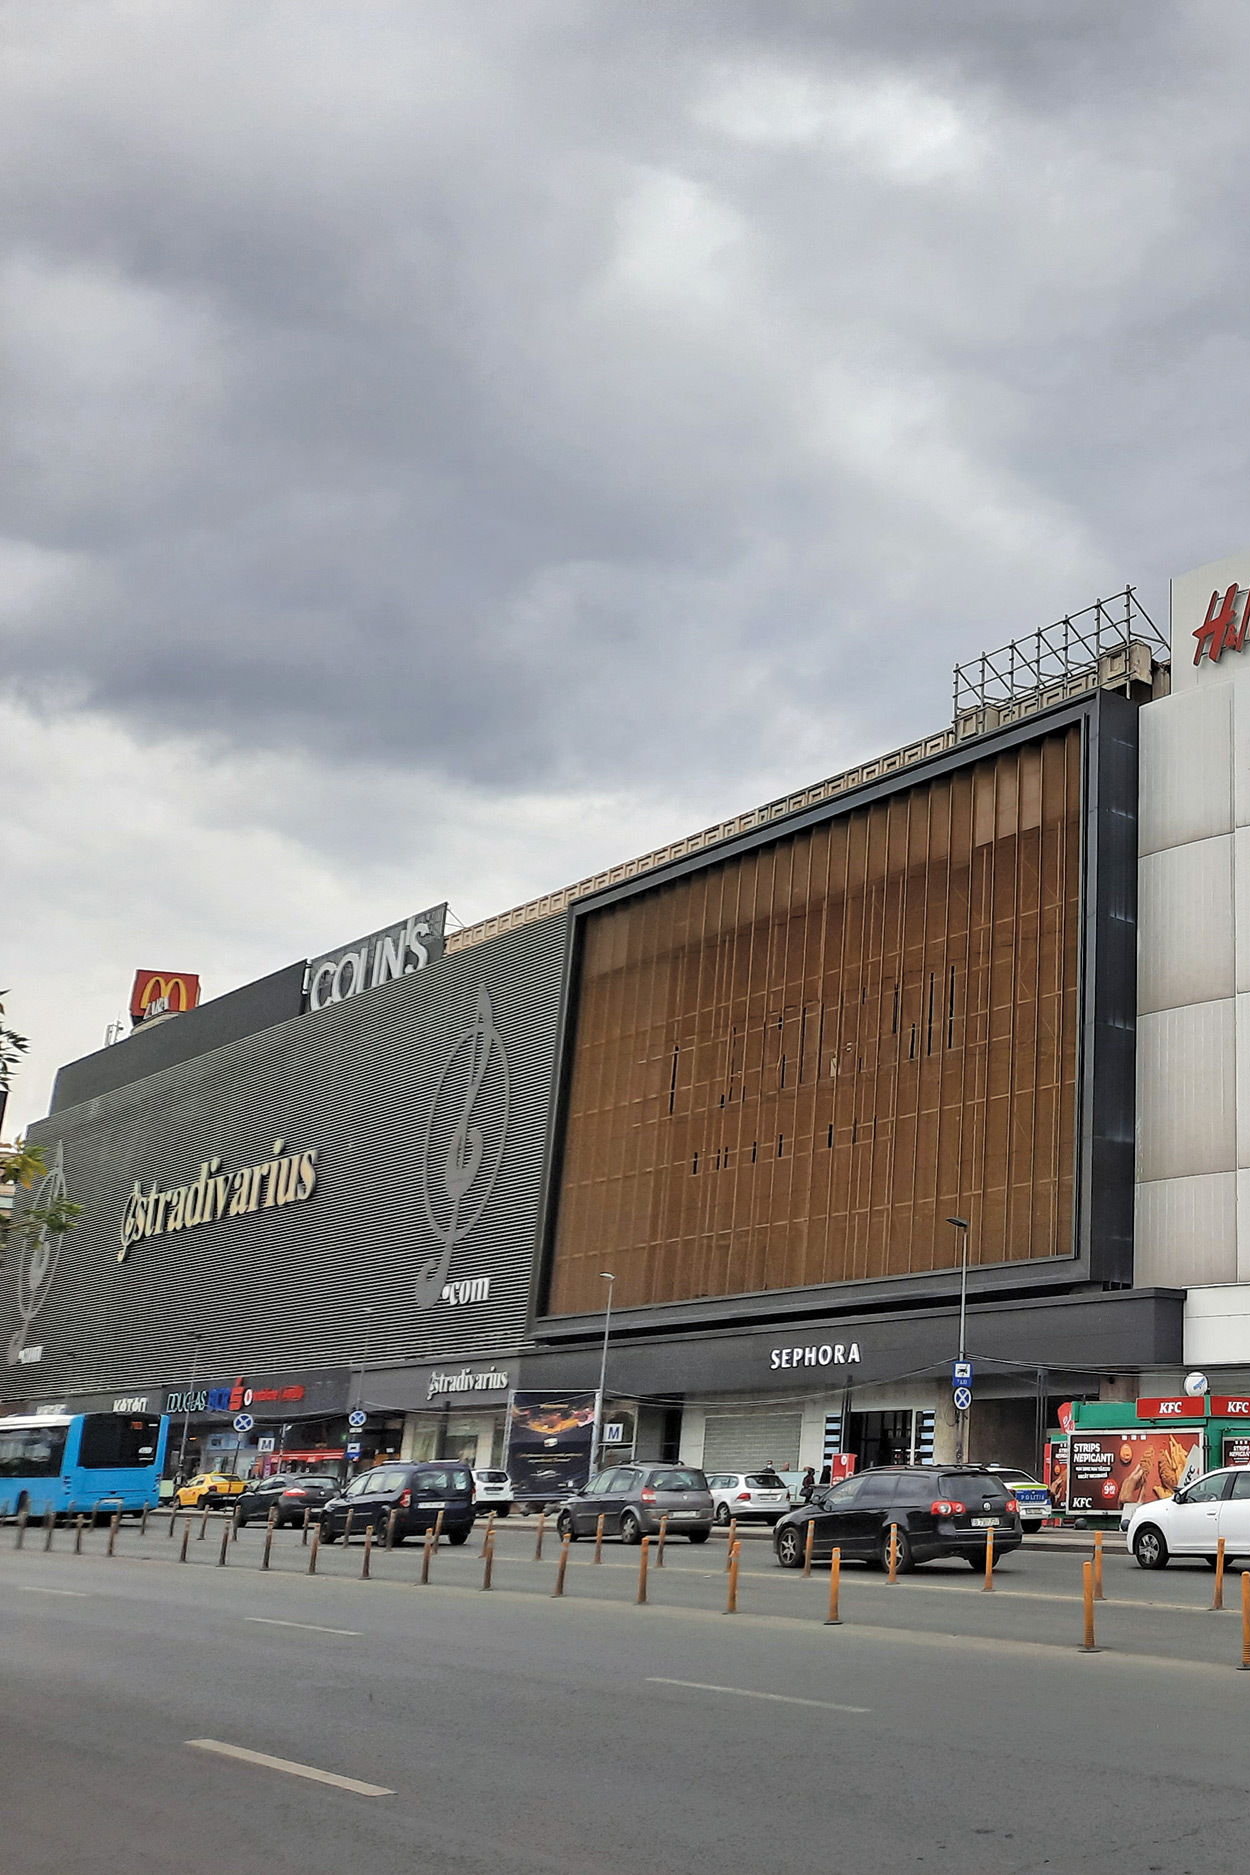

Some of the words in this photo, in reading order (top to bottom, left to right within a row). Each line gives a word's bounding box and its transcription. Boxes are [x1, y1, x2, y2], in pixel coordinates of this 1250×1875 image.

[117, 1138, 321, 1263] stradivarius
[770, 1342, 861, 1370] SEPHORA
[427, 1365, 508, 1400] stradivarius
[166, 1390, 208, 1413] DOUGLAS
[1159, 1401, 1183, 1414] KFC
[1227, 1401, 1250, 1413] KFC
[607, 1426, 621, 1440] M
[261, 1440, 272, 1450] M
[1073, 1443, 1101, 1453] STRIPS
[1072, 1497, 1093, 1508] KFC
